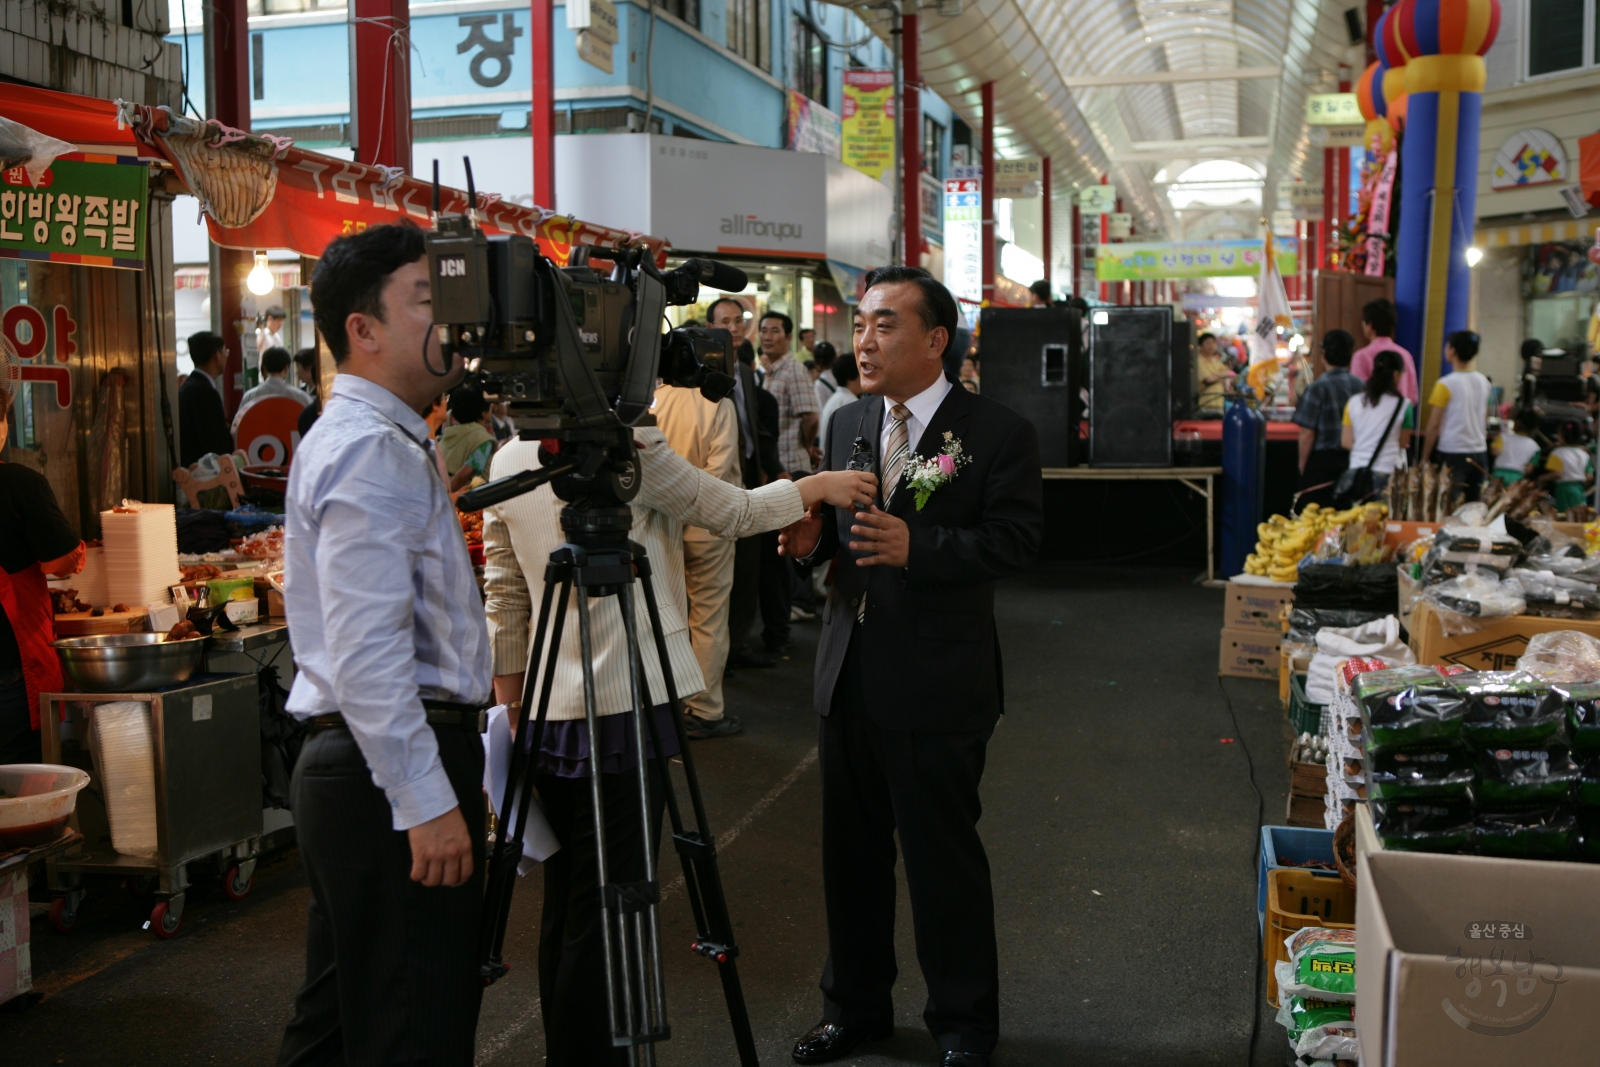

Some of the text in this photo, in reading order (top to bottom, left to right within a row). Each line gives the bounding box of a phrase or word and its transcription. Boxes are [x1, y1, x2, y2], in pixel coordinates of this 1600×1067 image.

[456, 13, 523, 88] 장
[0, 190, 140, 251] 한방왕족발
[439, 258, 466, 277] JCN
[3, 304, 77, 409] 약
[1312, 959, 1356, 974] 단백
